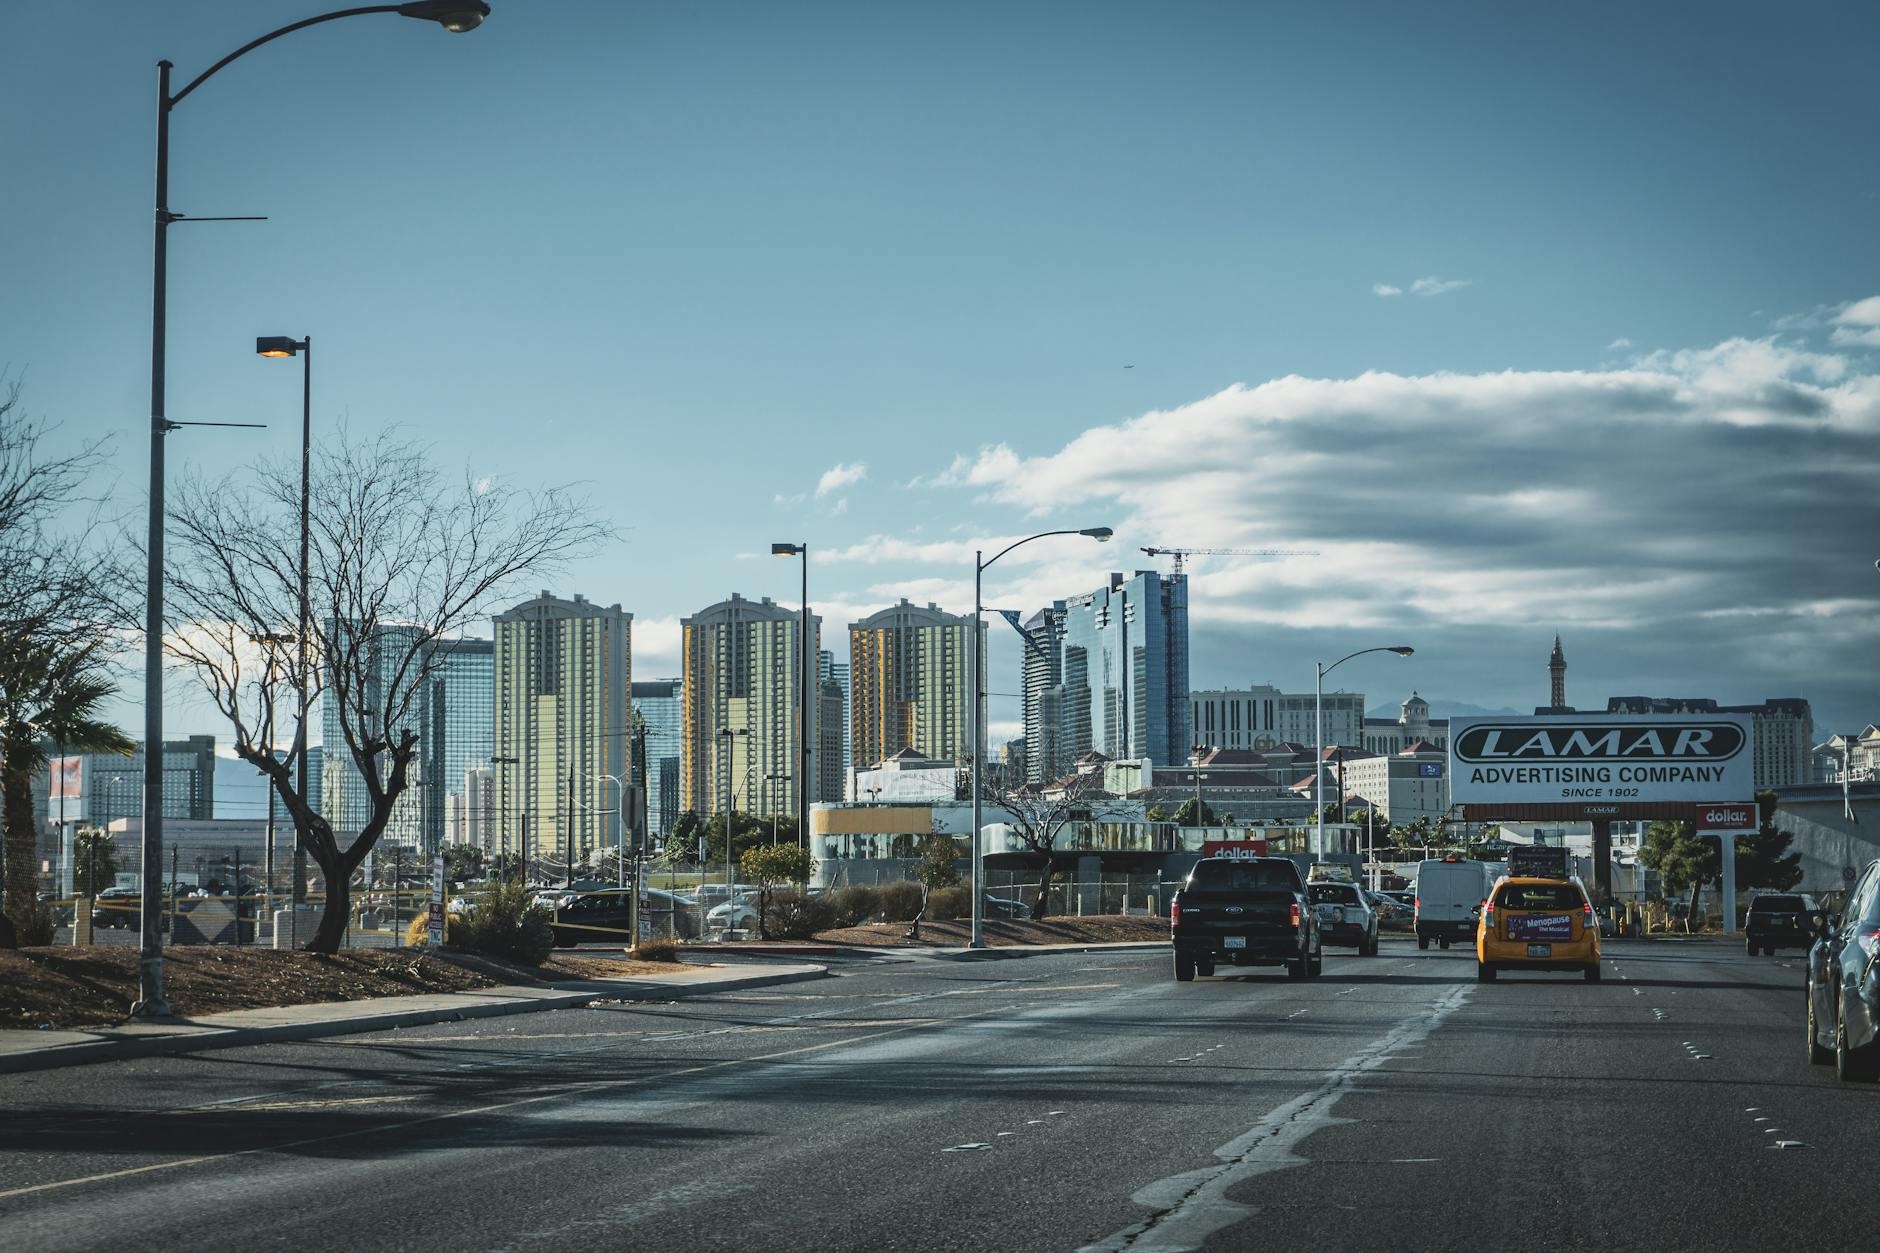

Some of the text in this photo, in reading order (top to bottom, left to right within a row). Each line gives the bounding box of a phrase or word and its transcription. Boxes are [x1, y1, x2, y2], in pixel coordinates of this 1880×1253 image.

[1480, 729, 1713, 757] LAMAR
[1470, 766, 1725, 784] ADVERTISING COMPANY
[1561, 788, 1640, 798] SINCE 1902
[1526, 915, 1570, 928] Menopause
